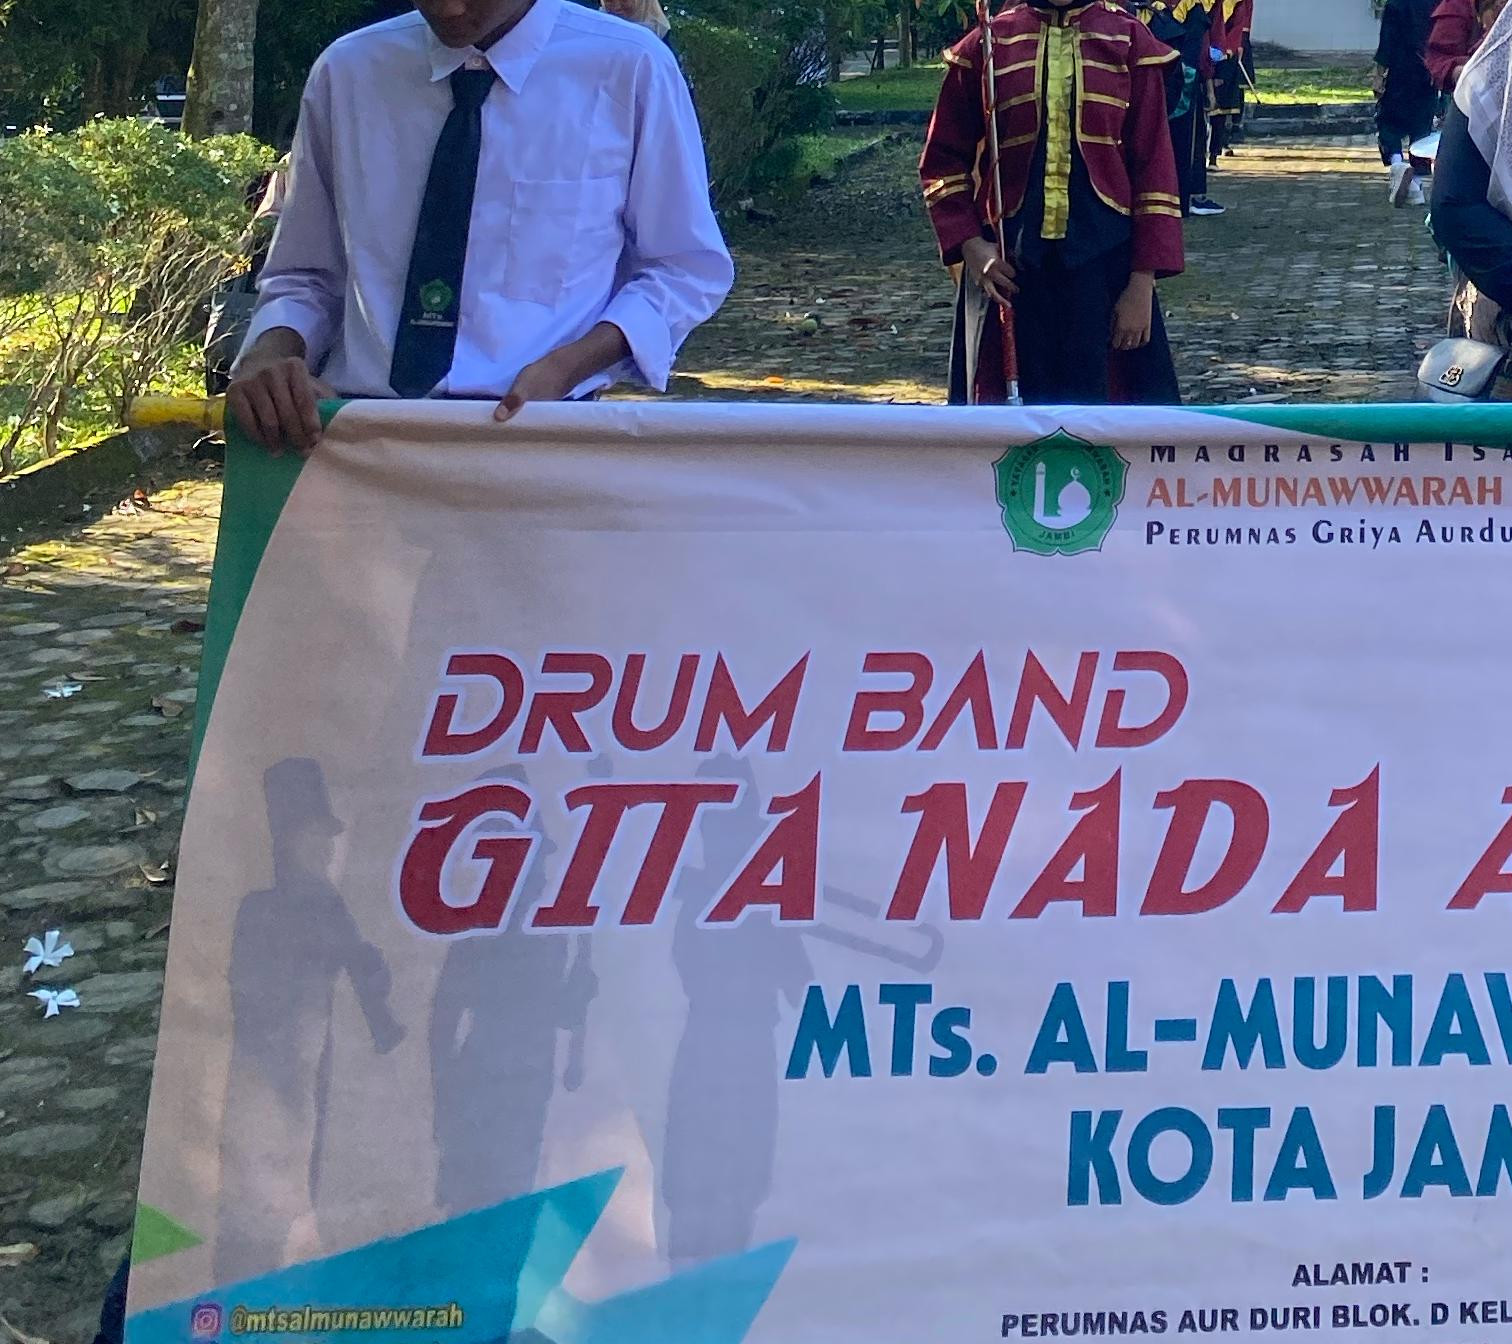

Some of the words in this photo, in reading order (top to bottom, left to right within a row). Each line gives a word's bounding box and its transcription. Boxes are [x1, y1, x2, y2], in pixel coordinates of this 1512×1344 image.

[1146, 476, 1502, 507] AL-MUNAWWARAH
[423, 649, 811, 756] DRUM
[842, 648, 1189, 751] BAND
[399, 770, 822, 934] GITA
[884, 765, 1380, 922] NADA
[785, 983, 998, 1080] MTs.
[1067, 1106, 1338, 1207] KOTA
[1291, 1261, 1413, 1287] ALAMAT
[231, 1303, 464, 1335] @mtsalmunawwarah
[1000, 1310, 1169, 1338] PERUMNAS
[1177, 1308, 1240, 1334] AUR
[1249, 1305, 1321, 1331] DURI
[1331, 1303, 1420, 1329] BLOK.
[1430, 1302, 1450, 1326] D
